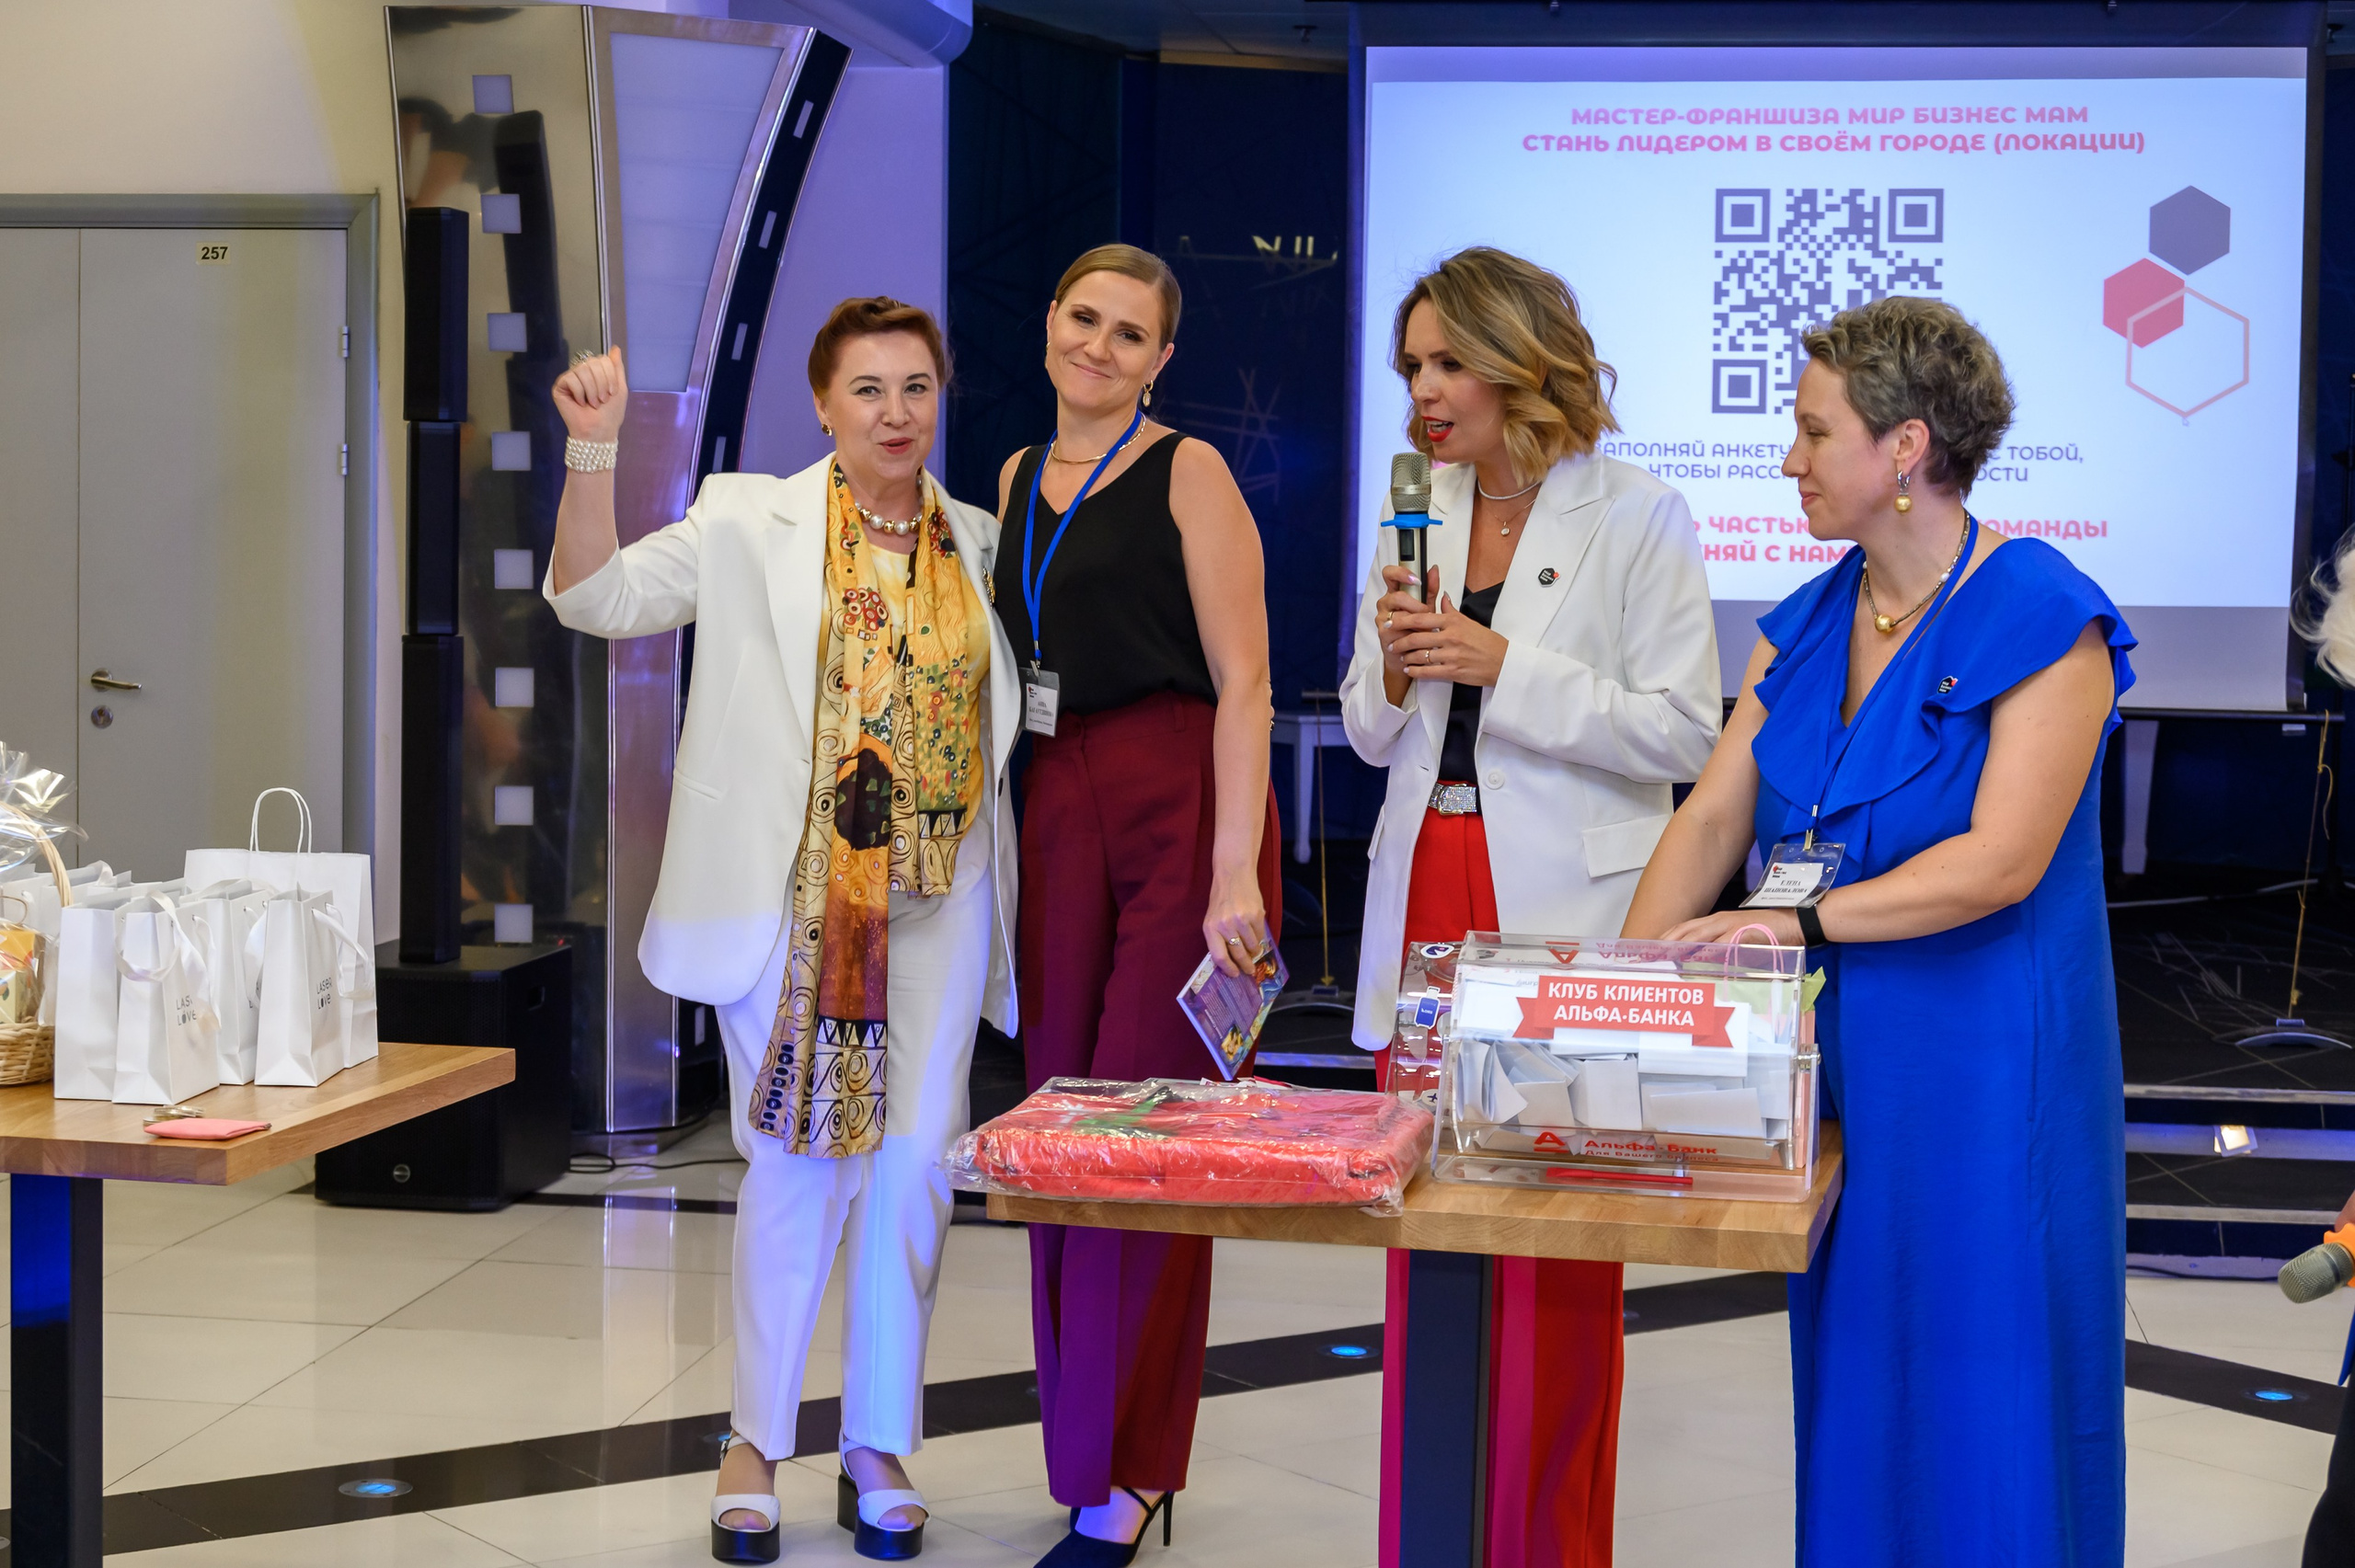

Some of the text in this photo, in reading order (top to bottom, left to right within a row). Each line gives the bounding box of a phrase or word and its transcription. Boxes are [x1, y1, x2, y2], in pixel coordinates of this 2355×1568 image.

[1571, 107, 2088, 125] МАСТЕР-ФРАНШИЗА МИР БИЗНЕС МАМ
[1522, 131, 2145, 155] СТАНЬ ЛИДЕРОМ В СВОЁМ ГОРОДЕ (ЛОКАЦИИ)
[201, 246, 228, 260] 257
[2006, 442, 2084, 464] ТОБОЙ,
[1648, 464, 1721, 479] ЧТОБЫ
[1728, 464, 1786, 480] РАСС
[1978, 519, 2108, 541] ОМАНДЫ
[1702, 539, 1851, 563] НЯЙ С НАМ
[1548, 981, 1598, 1001] КЛУБ
[1603, 984, 1705, 1005] КЛИЕНТОВ
